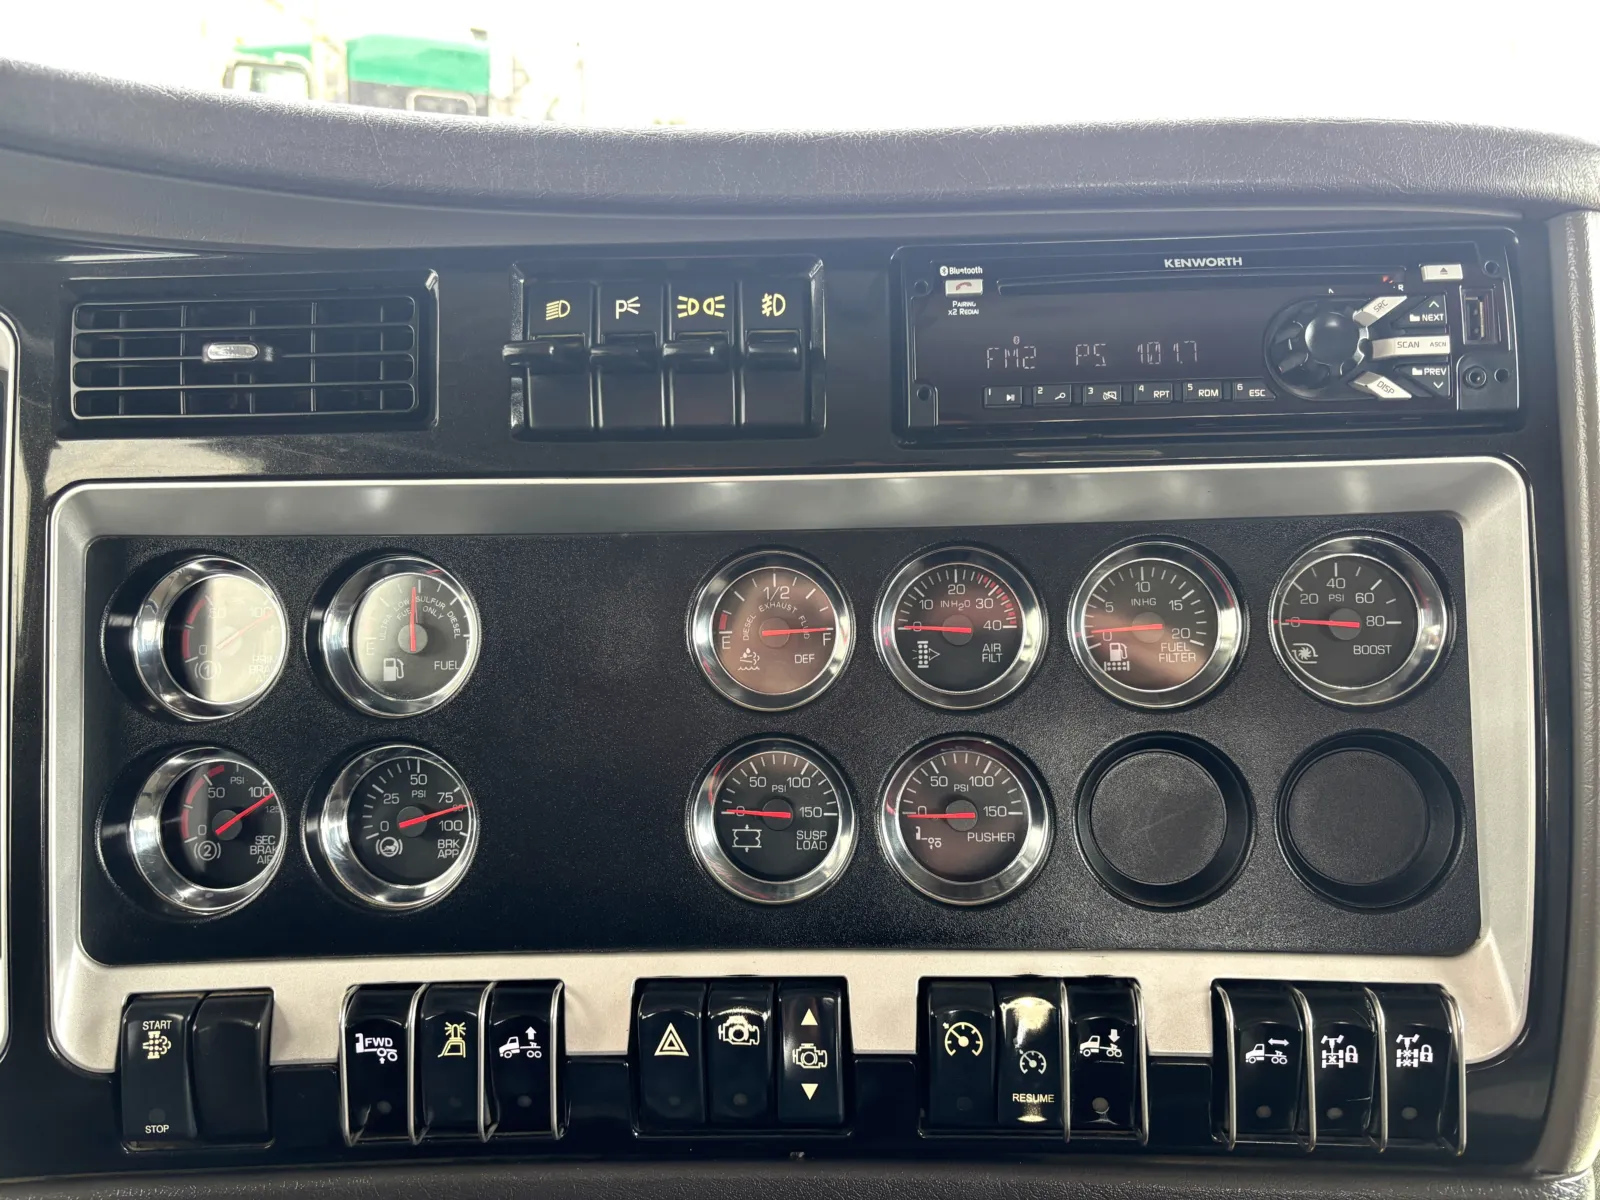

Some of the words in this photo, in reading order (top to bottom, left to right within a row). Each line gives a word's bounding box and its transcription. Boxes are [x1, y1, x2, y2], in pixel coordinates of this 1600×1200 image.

[1164, 256, 1242, 268] KENWORTH
[949, 266, 983, 275] Bluetooth
[1374, 300, 1388, 312] SRC
[1422, 313, 1444, 322] NEXT
[986, 346, 1036, 370] FM2
[1424, 367, 1447, 376] PREV
[1037, 387, 1043, 395] 2
[1088, 387, 1094, 395] 3
[1237, 383, 1243, 391] 6
[1249, 388, 1266, 397] ESC
[1376, 380, 1395, 394] DISP
[1153, 390, 1170, 399] RPT
[1198, 388, 1219, 398] RDM
[1134, 581, 1150, 593] 10
[1326, 577, 1346, 589] 40
[763, 586, 790, 601] 1/2
[948, 584, 966, 595] 20
[1300, 594, 1319, 605] 20
[1328, 594, 1345, 602] PSI
[1355, 592, 1375, 604] 60
[918, 600, 934, 610] 10
[975, 598, 994, 610] 30
[1105, 602, 1114, 613] 5
[1168, 600, 1183, 611] 15
[379, 614, 392, 641] ULTRA
[394, 597, 410, 611] LOW
[415, 595, 446, 610] SULFUR
[446, 610, 462, 640] DIESEL
[397, 608, 413, 620] FUE
[422, 606, 445, 620] ONLY
[742, 614, 757, 641] DIESEL
[758, 602, 798, 614] EXHAUST
[798, 615, 810, 640] FLD
[983, 620, 1002, 631] 40
[1366, 615, 1385, 627] 80
[822, 632, 832, 646] F
[1172, 628, 1190, 640] 20
[366, 641, 375, 656] E
[722, 636, 731, 650] E
[982, 643, 1002, 653] AIR
[1160, 642, 1188, 652] FUEL
[1353, 644, 1392, 655] BOOST
[794, 654, 815, 664] DEF
[982, 654, 1003, 663] FILT
[1158, 652, 1196, 663] FILTER
[434, 660, 461, 670] FUEL
[410, 774, 428, 786] 50
[750, 777, 767, 788] 50
[787, 777, 811, 788] 100
[930, 776, 948, 788] 50
[969, 776, 994, 788] 100
[208, 787, 226, 798] 50
[248, 786, 272, 798] 100
[954, 784, 969, 792] PSI
[383, 793, 400, 805] 25
[412, 790, 426, 798] PSI
[437, 792, 454, 804] 75
[799, 807, 823, 818] 150
[918, 806, 927, 816] 0
[983, 806, 1007, 817] 150
[198, 824, 207, 836] 0
[380, 821, 390, 832] 0
[439, 820, 463, 832] 100
[255, 835, 276, 845] SEC
[796, 830, 828, 840] SUSP
[967, 832, 1015, 843] PUSHER
[437, 839, 460, 849] BRK
[796, 841, 828, 851] LOAD
[437, 850, 459, 859] APP
[142, 1020, 172, 1030] START
[364, 1037, 393, 1047] FWD
[1012, 1093, 1055, 1103] RESUME
[145, 1124, 170, 1134] STOP
